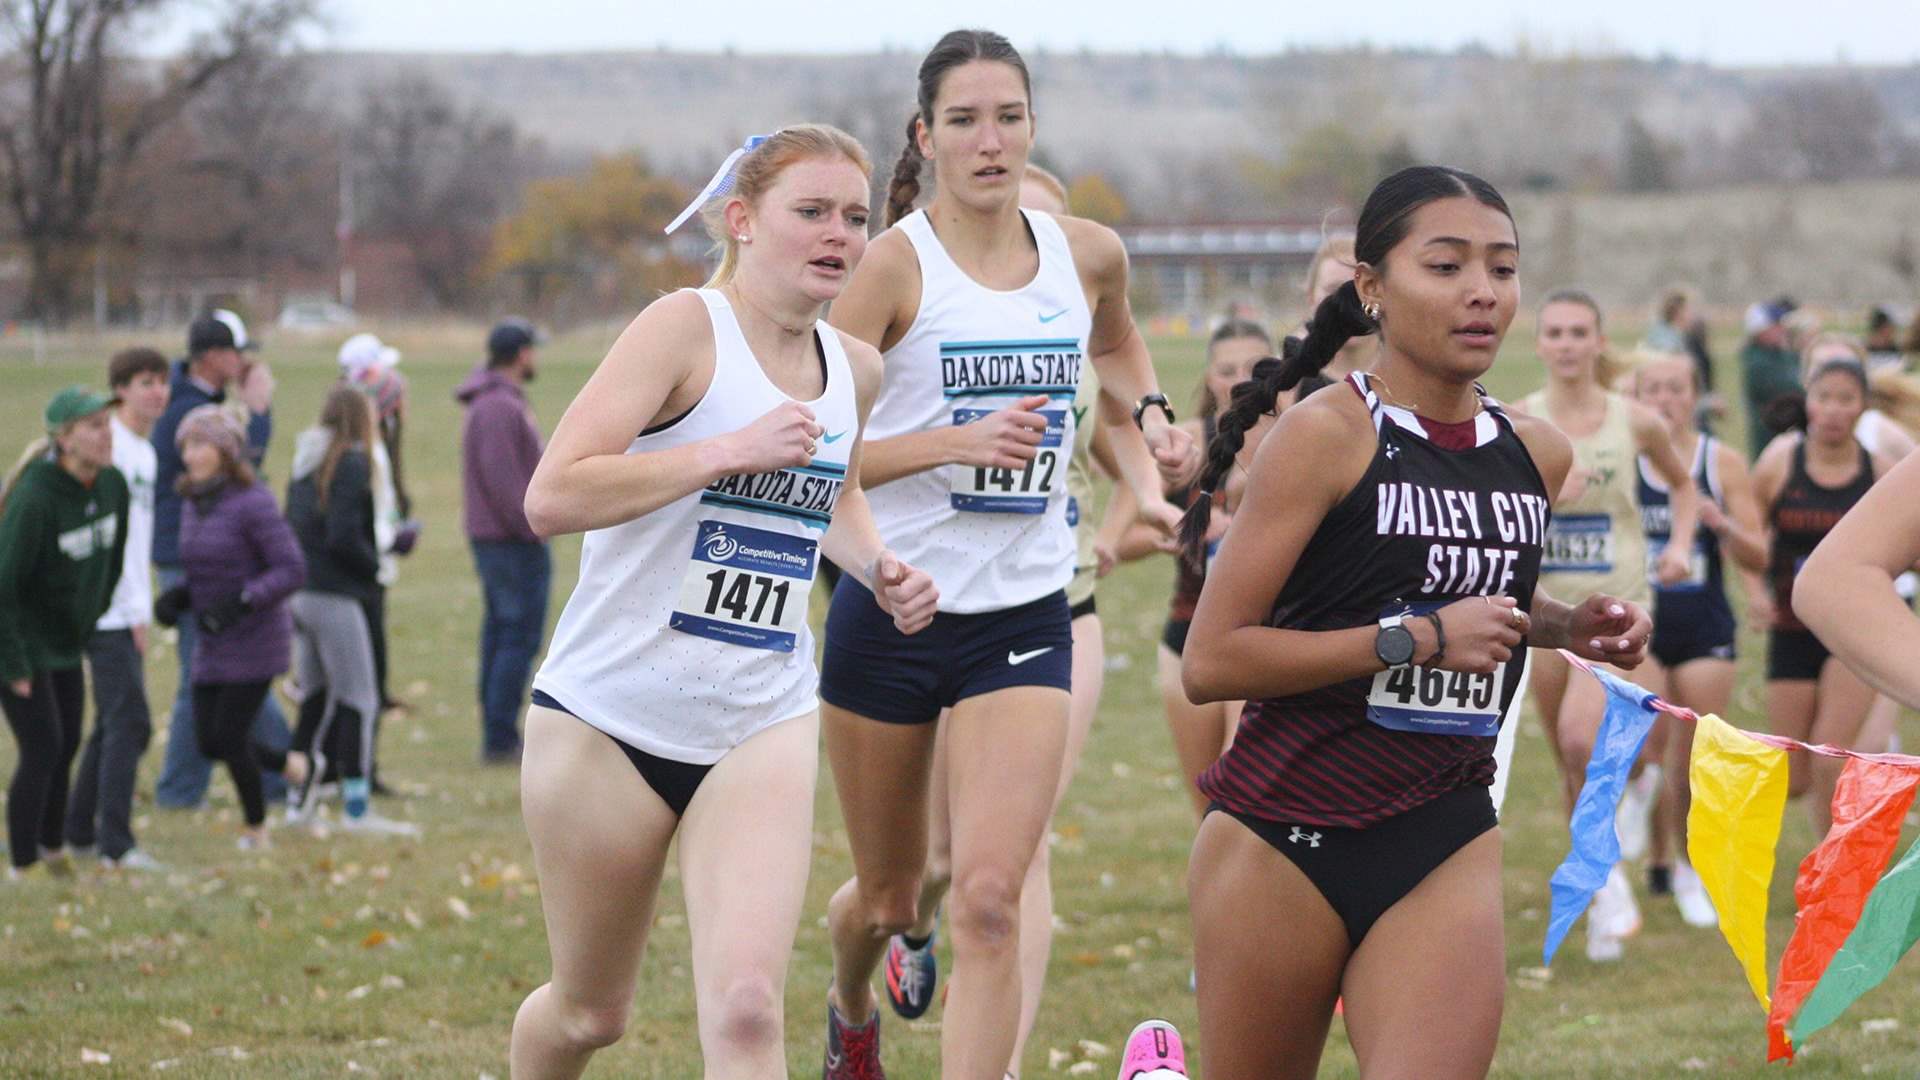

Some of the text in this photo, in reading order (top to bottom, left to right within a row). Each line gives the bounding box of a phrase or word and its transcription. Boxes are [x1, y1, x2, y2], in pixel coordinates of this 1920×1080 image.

[941, 354, 1081, 388] DAKOTA STATE
[1377, 483, 1547, 548] VALLEY CITY
[1420, 543, 1519, 597] STATE
[704, 569, 790, 626] 1471
[1385, 664, 1495, 710] 4645
